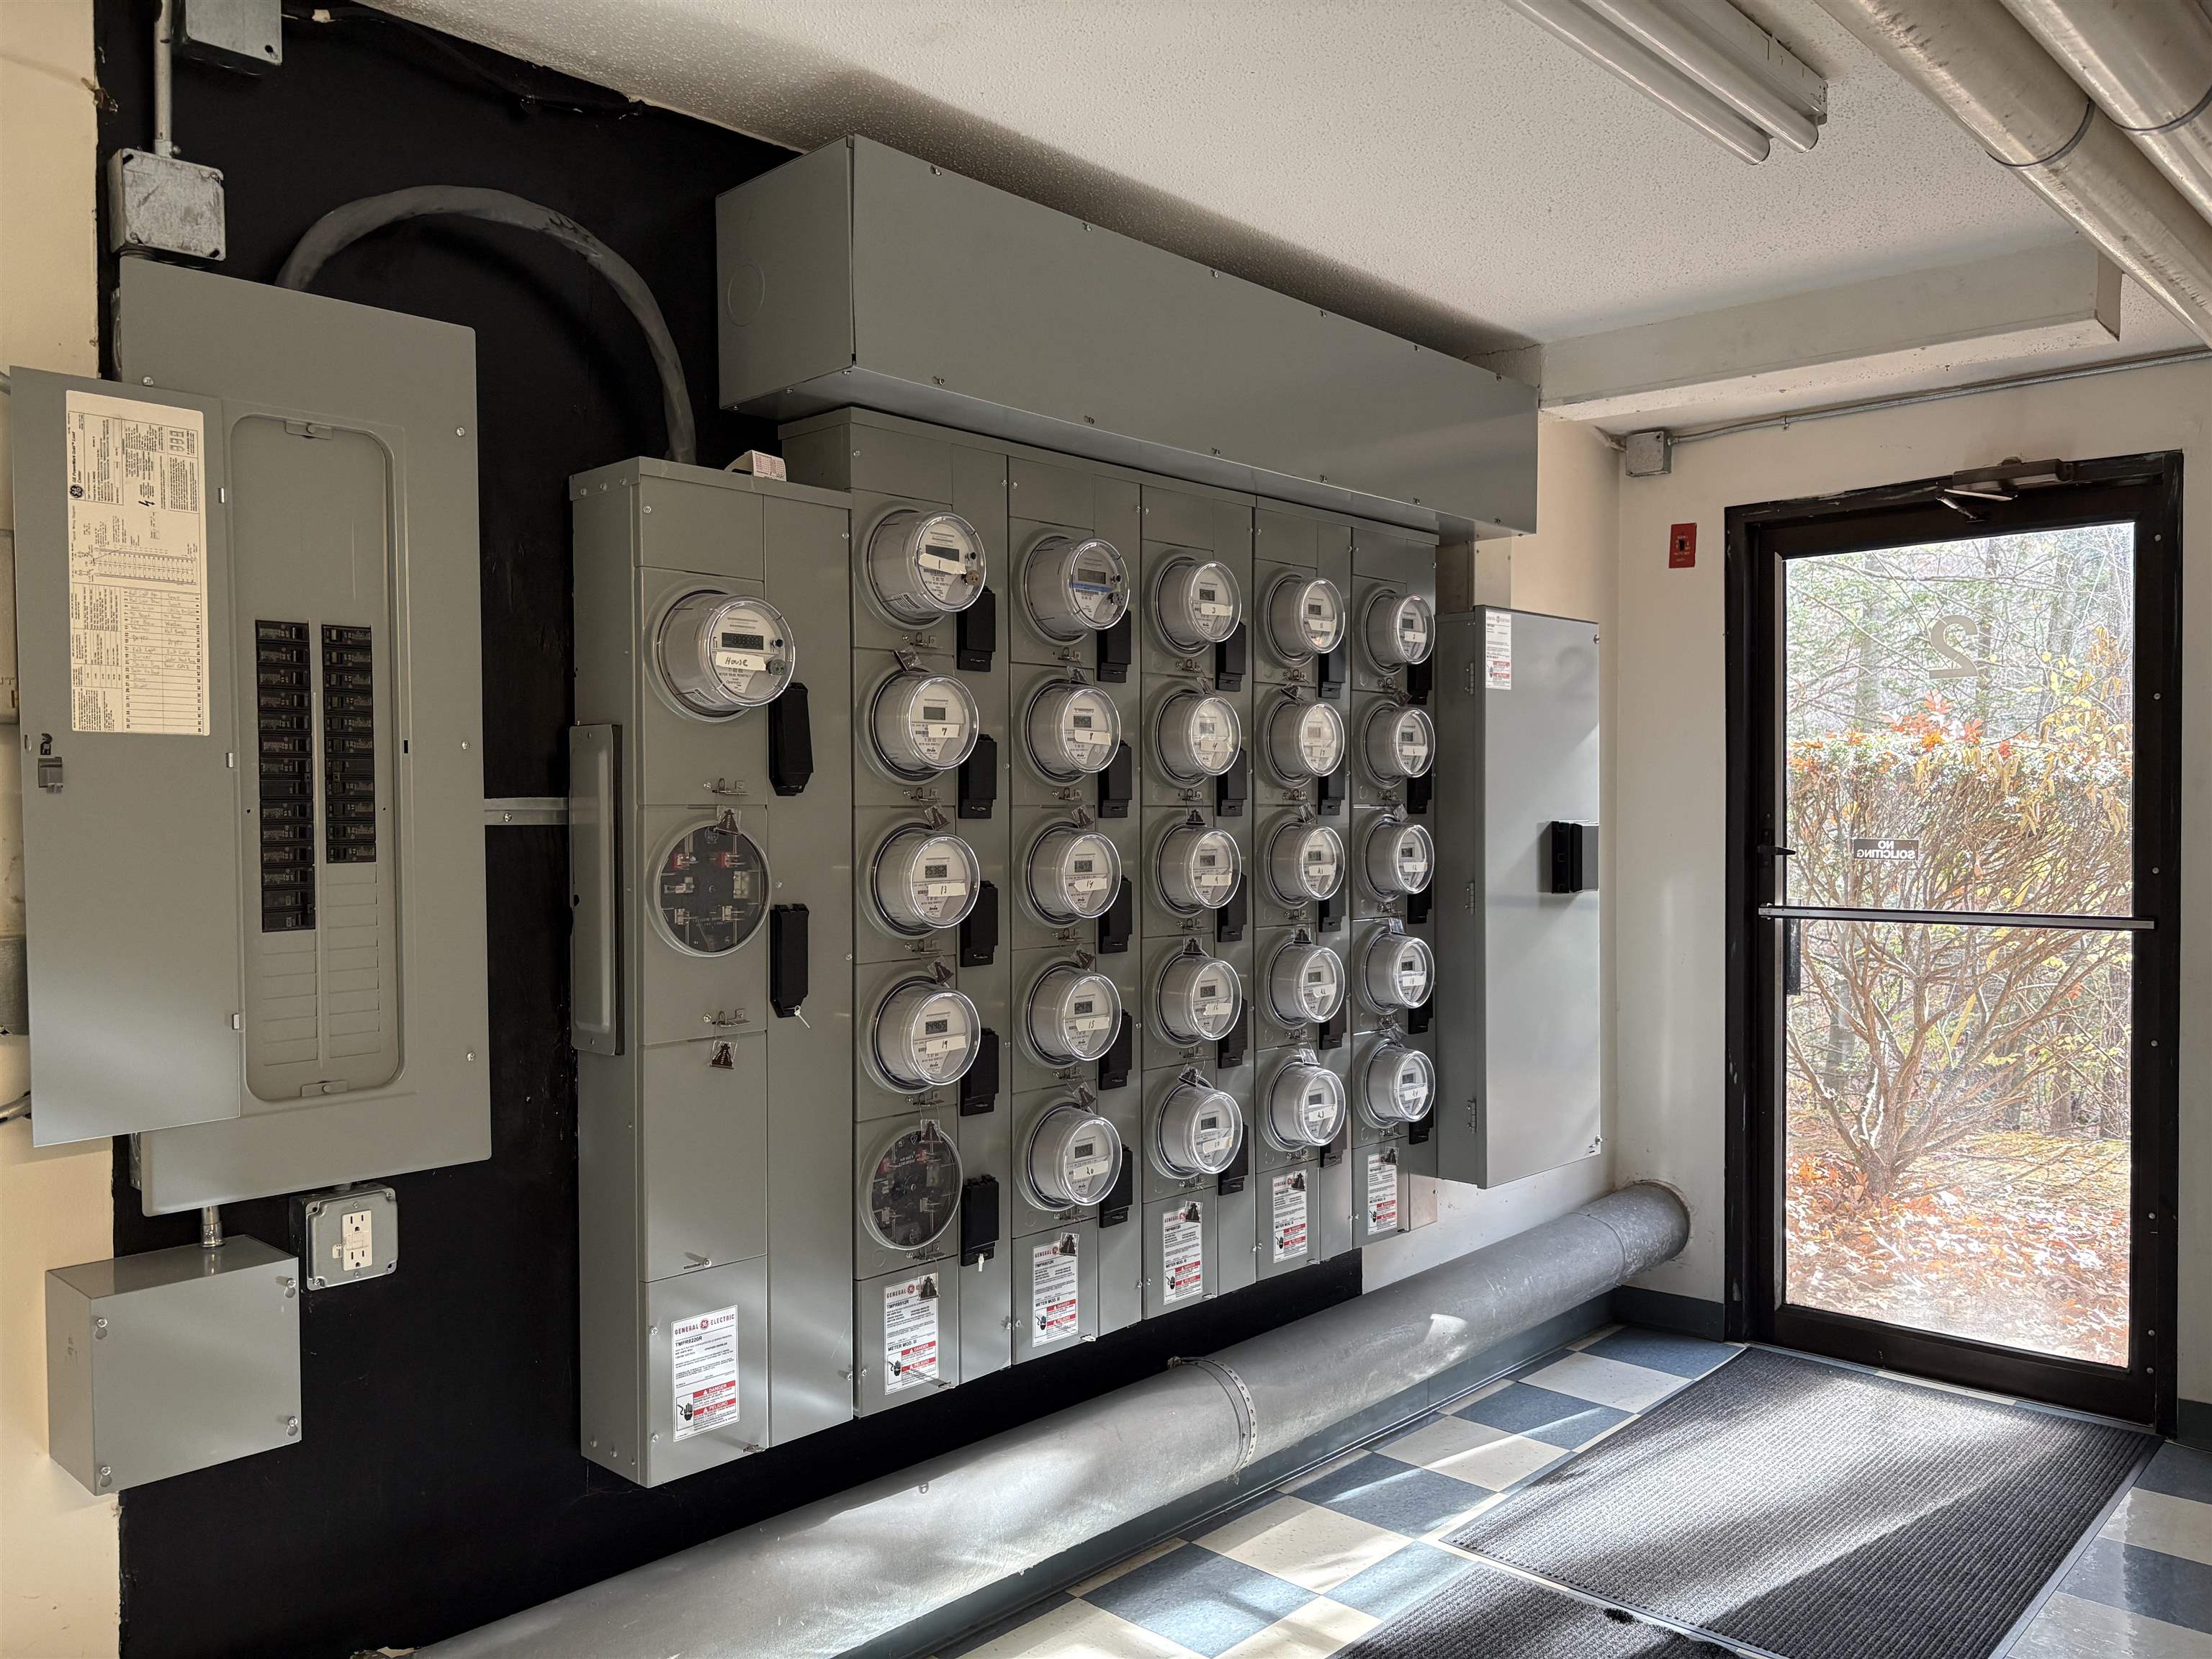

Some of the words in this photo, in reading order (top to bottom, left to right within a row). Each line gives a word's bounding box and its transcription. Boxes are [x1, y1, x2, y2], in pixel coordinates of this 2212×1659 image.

[725, 656, 748, 667] House
[942, 727, 948, 736] 7
[940, 886, 947, 895] 13
[1088, 1020, 1094, 1029] 15
[942, 1040, 948, 1049] 19
[887, 1289, 906, 1298] GENERAL
[675, 1323, 698, 1335] GENERAL
[711, 1314, 734, 1325] ELECTRIC
[709, 1383, 727, 1393] DANGER
[709, 1401, 728, 1411] PELIGRO
